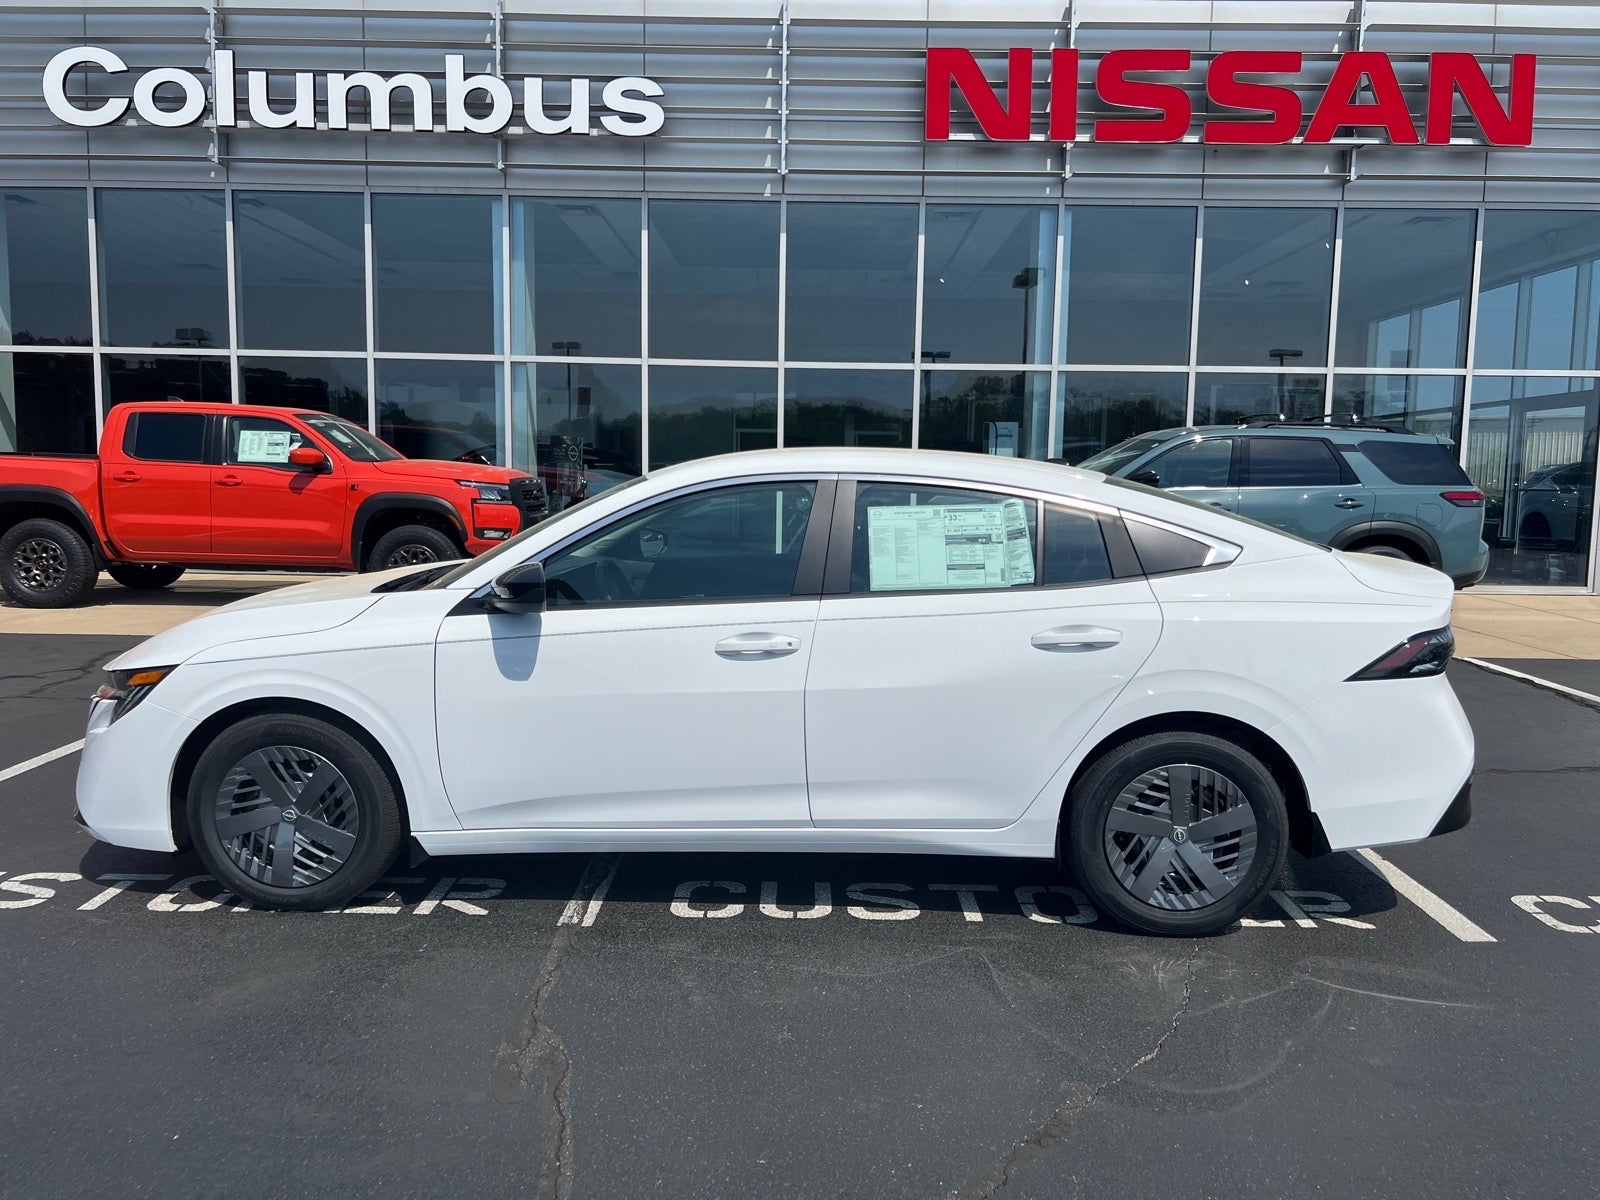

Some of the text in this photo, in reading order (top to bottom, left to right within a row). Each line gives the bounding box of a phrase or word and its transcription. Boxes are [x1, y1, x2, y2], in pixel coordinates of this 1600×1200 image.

[42, 45, 665, 137] Columbus
[924, 46, 1537, 146] NISSAN
[669, 880, 1376, 930] CUSTOR
